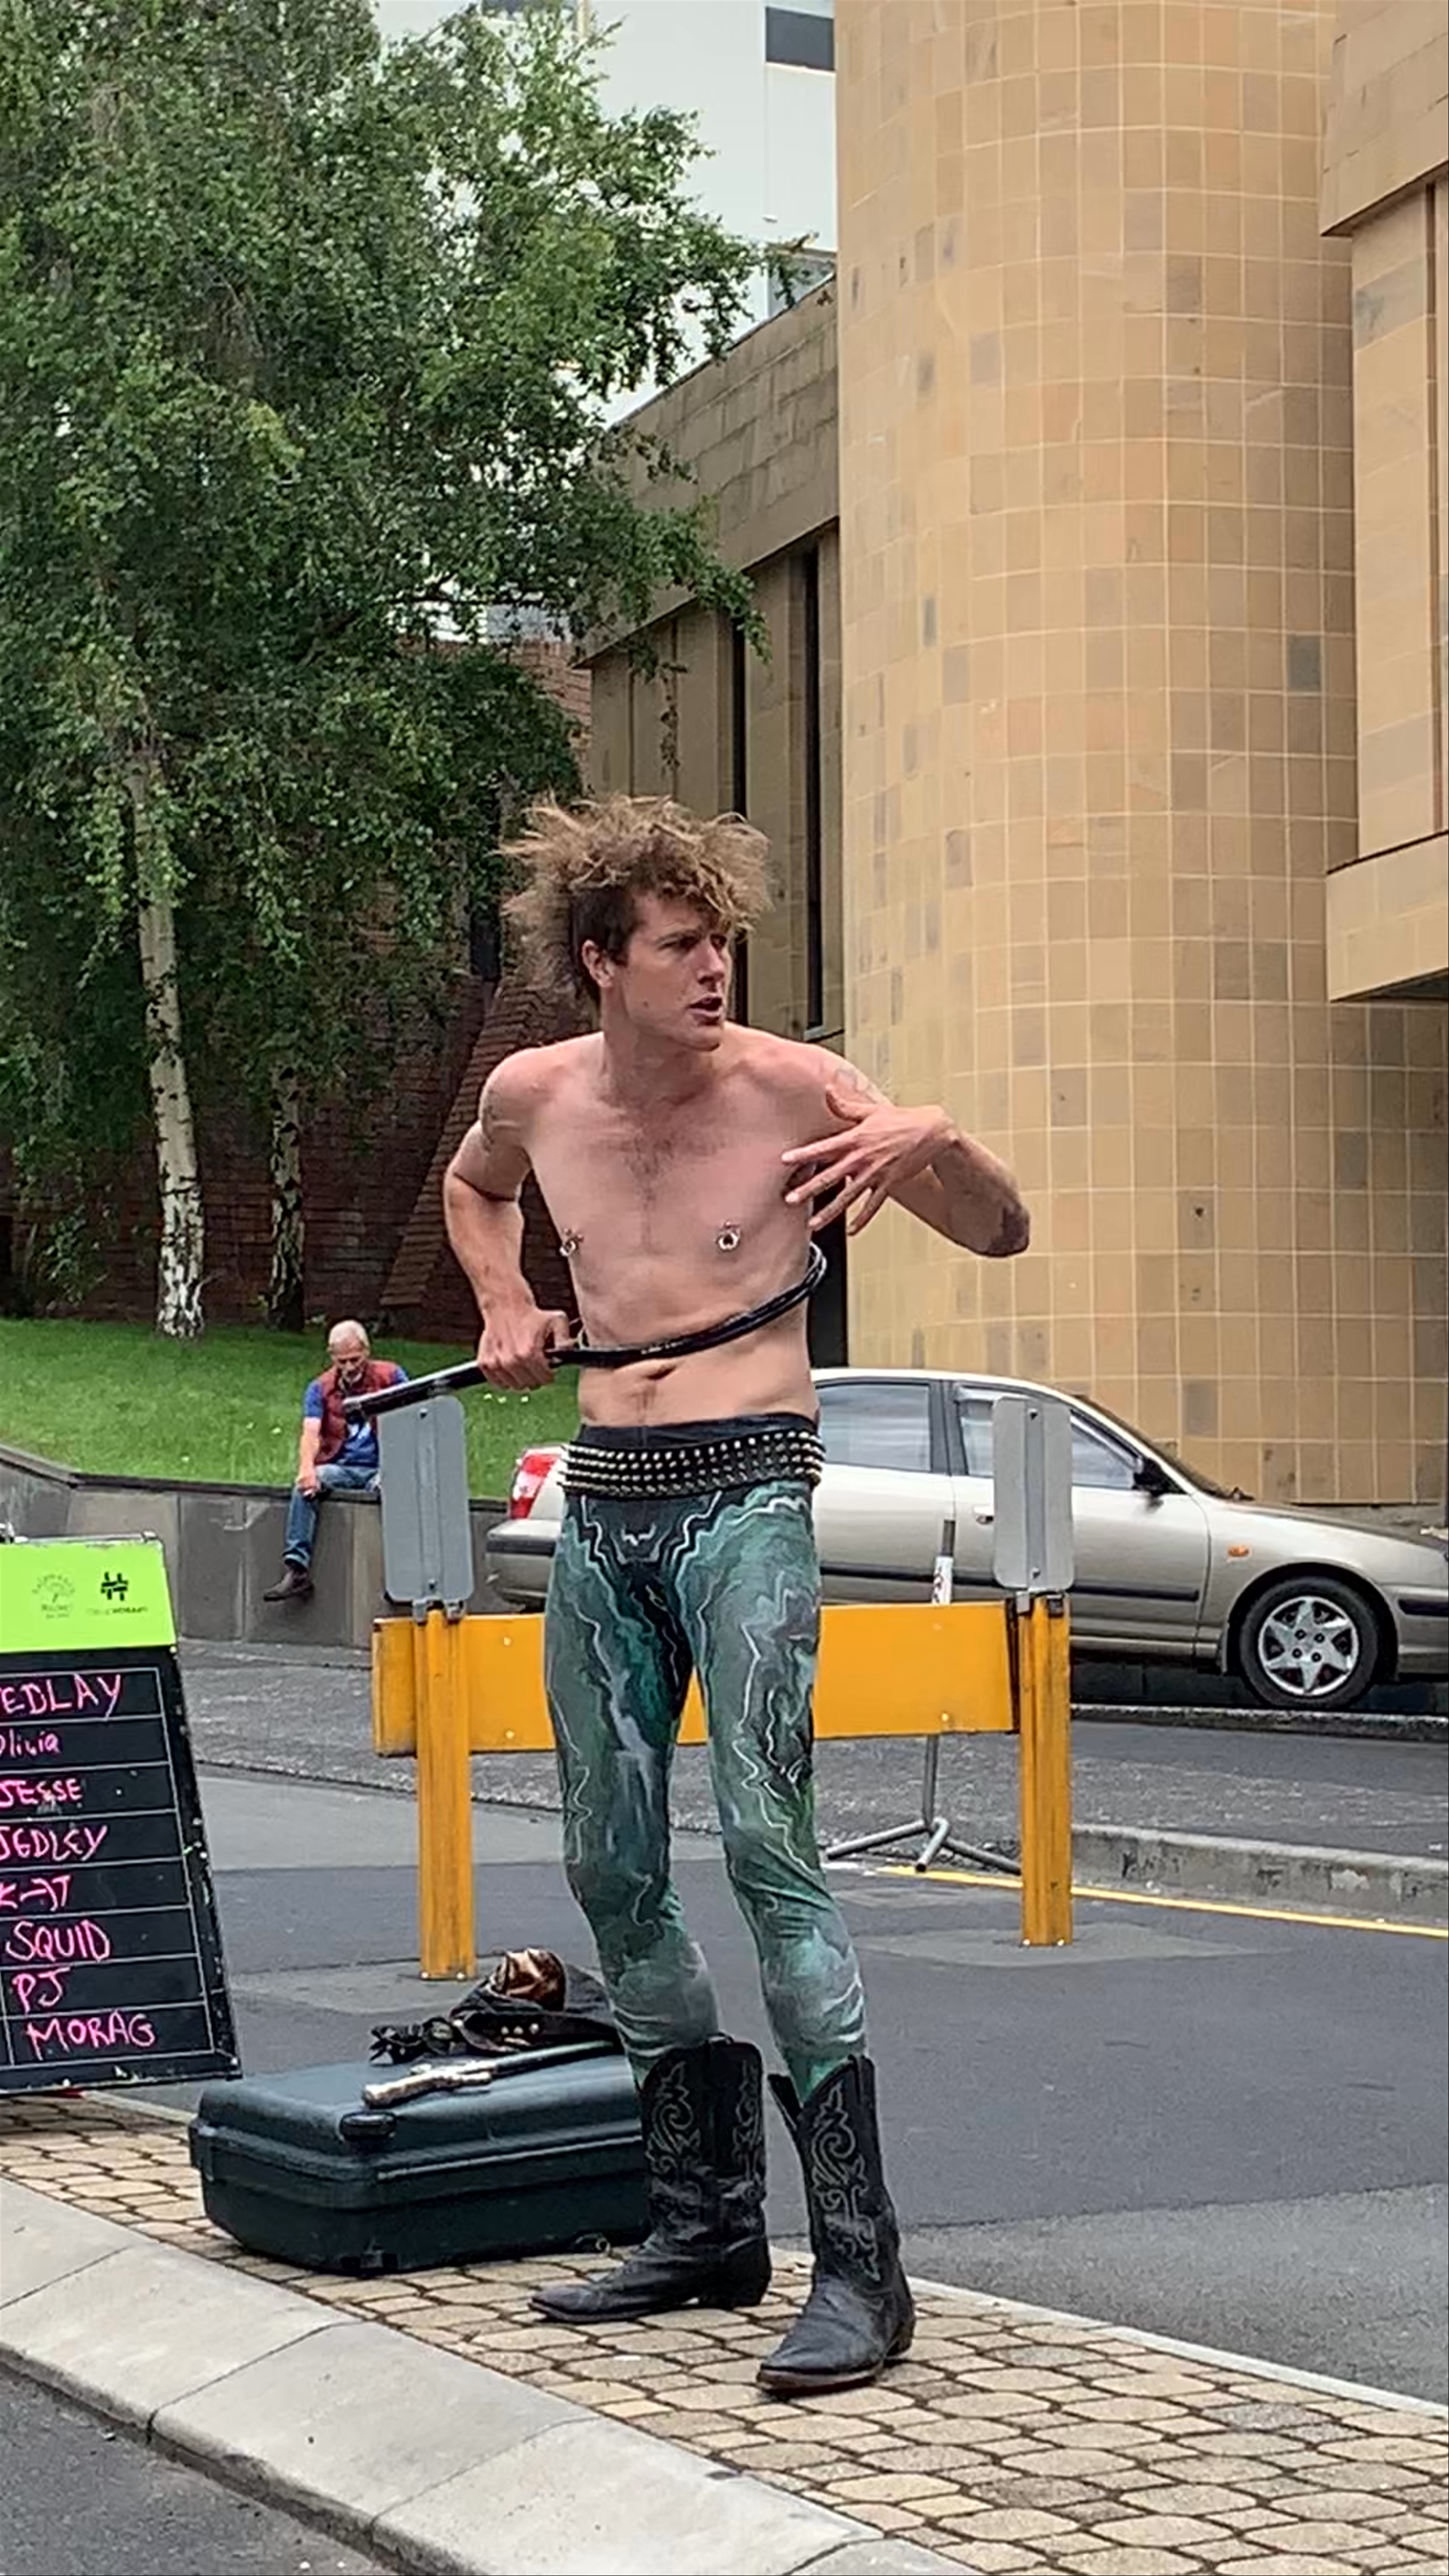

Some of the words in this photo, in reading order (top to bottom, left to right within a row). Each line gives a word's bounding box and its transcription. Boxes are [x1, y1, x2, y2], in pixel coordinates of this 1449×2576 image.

[0, 1673, 121, 1721] EDLAY
[5, 1919, 110, 1962] SQUID
[12, 1967, 71, 2014] PJ
[26, 2009, 155, 2061] MORAG
